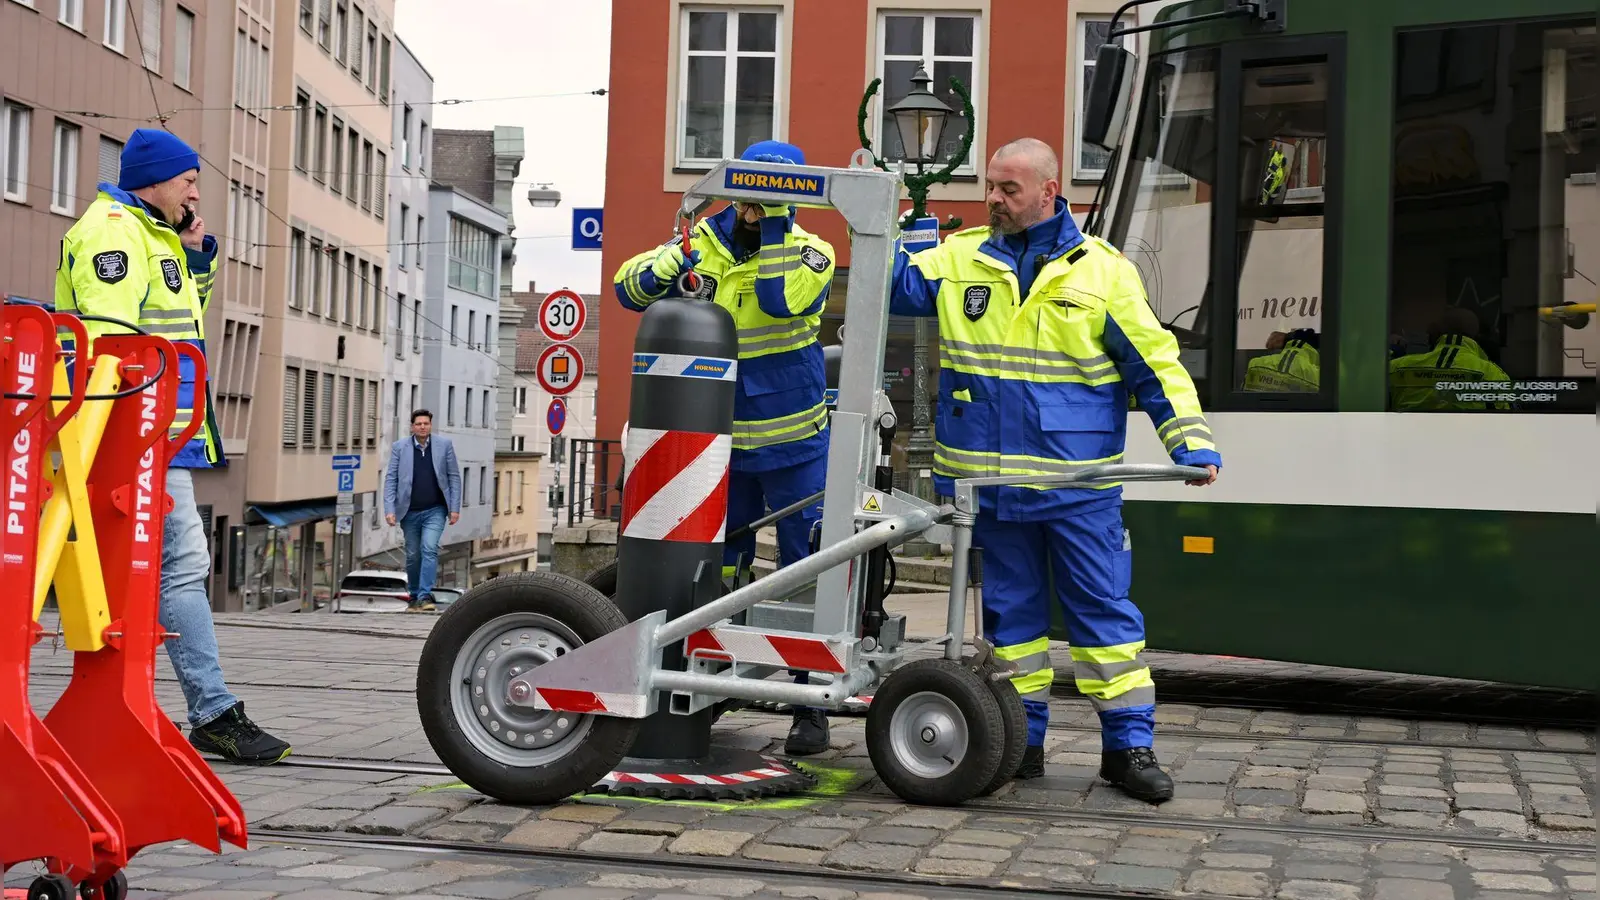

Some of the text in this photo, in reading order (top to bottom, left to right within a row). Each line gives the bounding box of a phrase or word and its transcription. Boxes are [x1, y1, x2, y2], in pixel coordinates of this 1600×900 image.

[731, 172, 818, 192] HÖRMANN
[549, 304, 576, 327] 30
[1435, 381, 1578, 391] STADTWERKE AUGSBURG
[1455, 393, 1557, 402] VERKEHRS-GMBH
[341, 472, 351, 489] P
